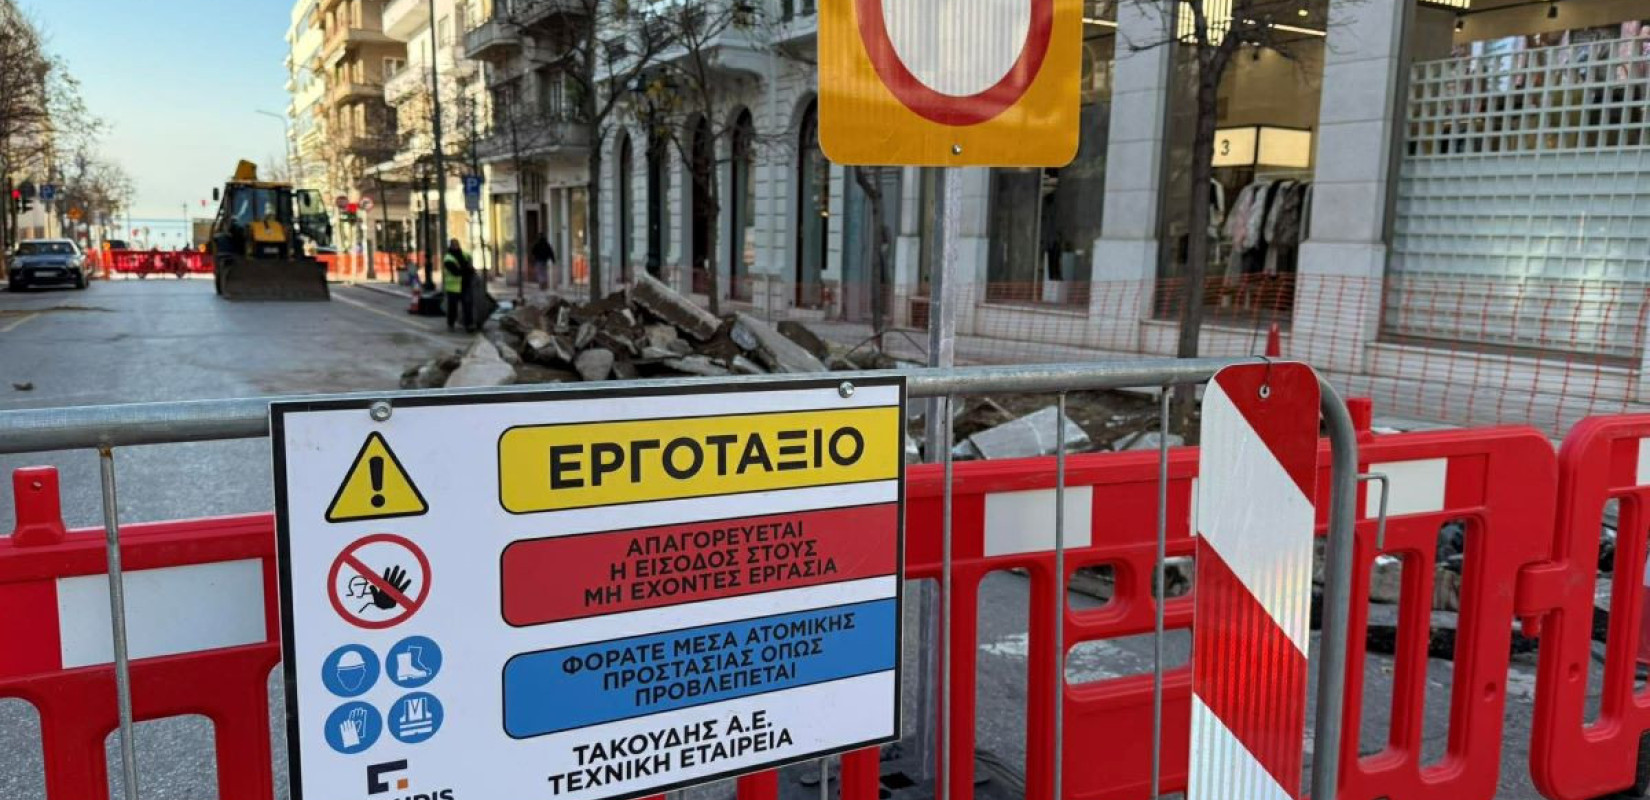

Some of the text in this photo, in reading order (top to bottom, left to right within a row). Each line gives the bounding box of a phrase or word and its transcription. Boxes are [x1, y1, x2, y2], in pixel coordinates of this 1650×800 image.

[1220, 139, 1230, 156] 3
[550, 426, 864, 490] ΕΡΓΟΤΑΞΙΟ
[610, 539, 818, 581] Η ΕΙΣΟΔΟΣ ΣΤΟΥΣ
[626, 520, 804, 557] ΑΠΑΓΟΡΕΥΕΤΑΙ
[584, 557, 838, 607] ΜΗ ΕΧΟΝΤΕΣ ΕΡΓΑΣΙΑ
[561, 612, 855, 675] ΦΟΡΑΤΕ ΜΕΣΑ ΑΤΟΜΙΚΗΣ
[603, 637, 823, 691] ΠΡΟΣΤΑΣΙΑΣ ΟΠΩΣ
[635, 662, 797, 706] ΠΡΟΒΛΕΠΕΤΑΙ
[548, 727, 793, 796] ΤΕΧΝΙΚΗ ΕΤΑΙΡΕΙΑ
[572, 709, 773, 766] ΤΑΚΟΥΔΗΣ Α.Ε.
